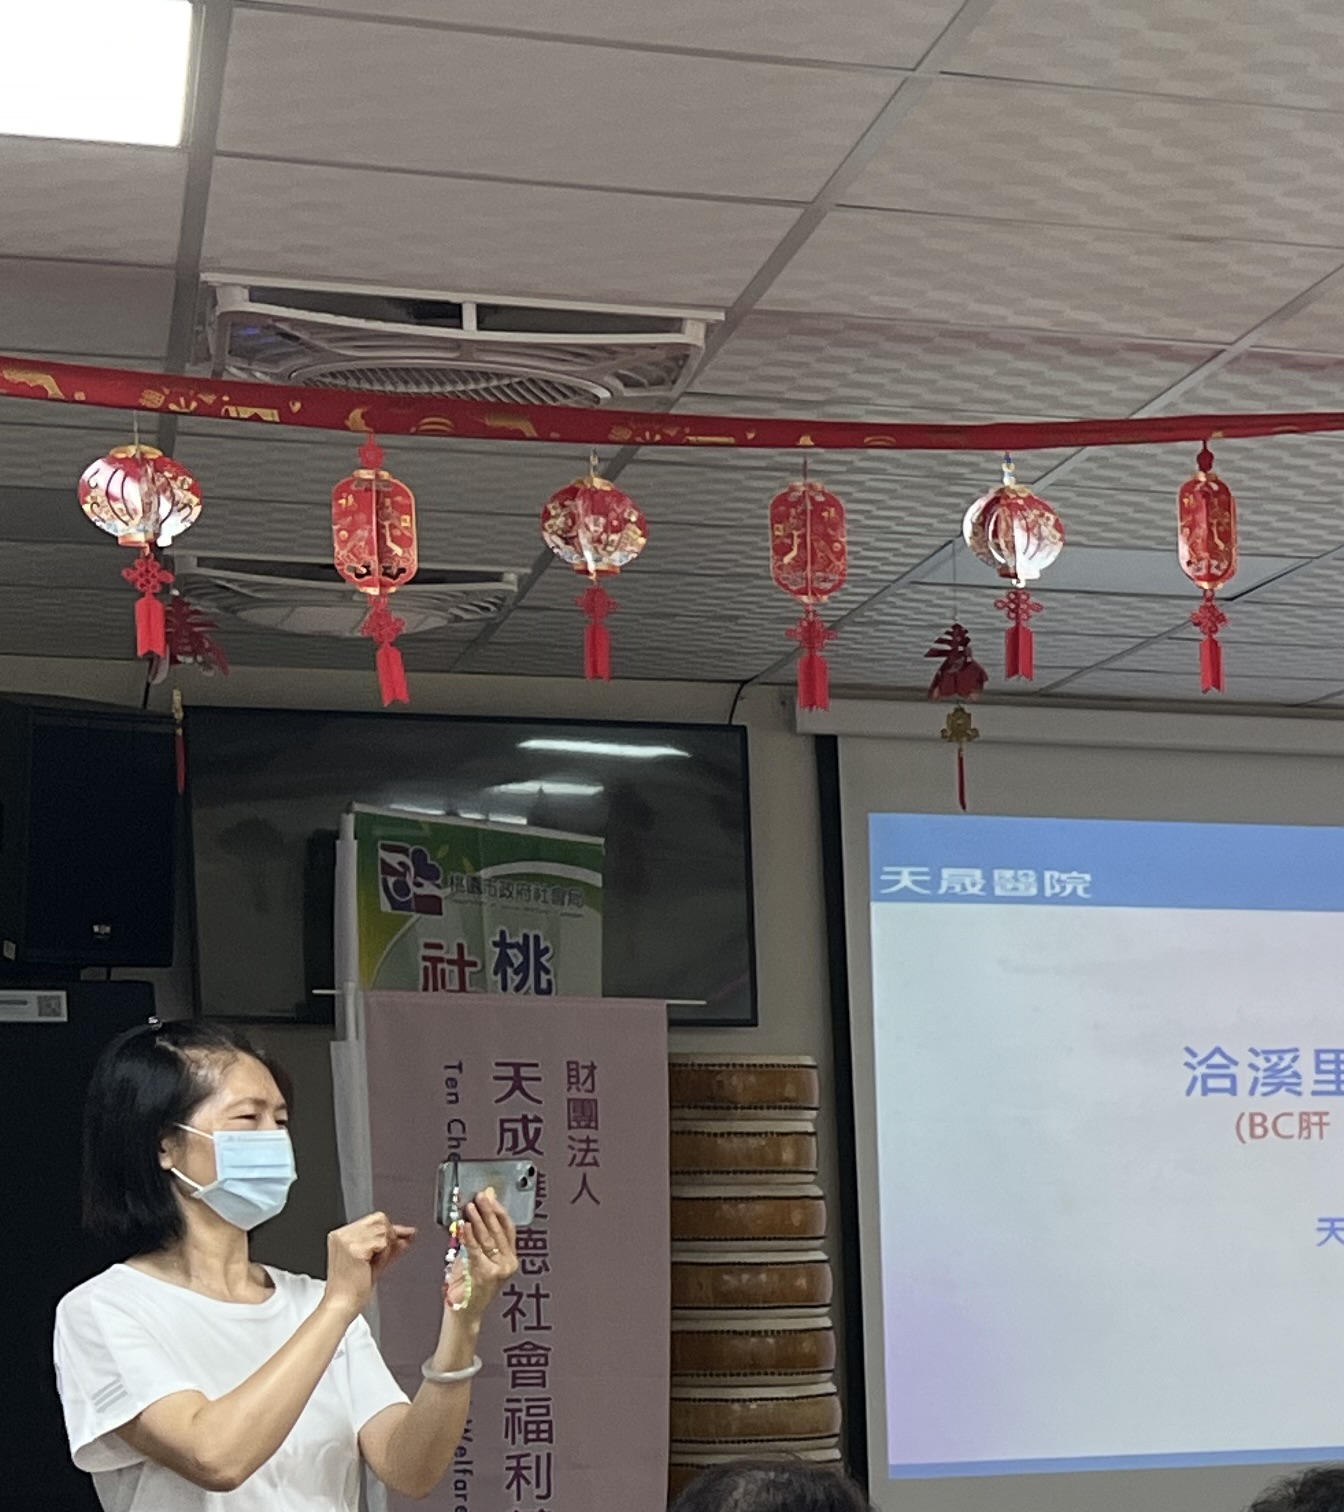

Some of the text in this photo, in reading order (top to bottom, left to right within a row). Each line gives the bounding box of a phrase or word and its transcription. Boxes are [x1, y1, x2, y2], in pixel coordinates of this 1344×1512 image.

[879, 865, 1092, 899] 天晟醫院
[421, 942, 478, 992] 社
[492, 929, 553, 994] 桃
[444, 1061, 462, 1105] Ten
[566, 1060, 601, 1206] 財團法人
